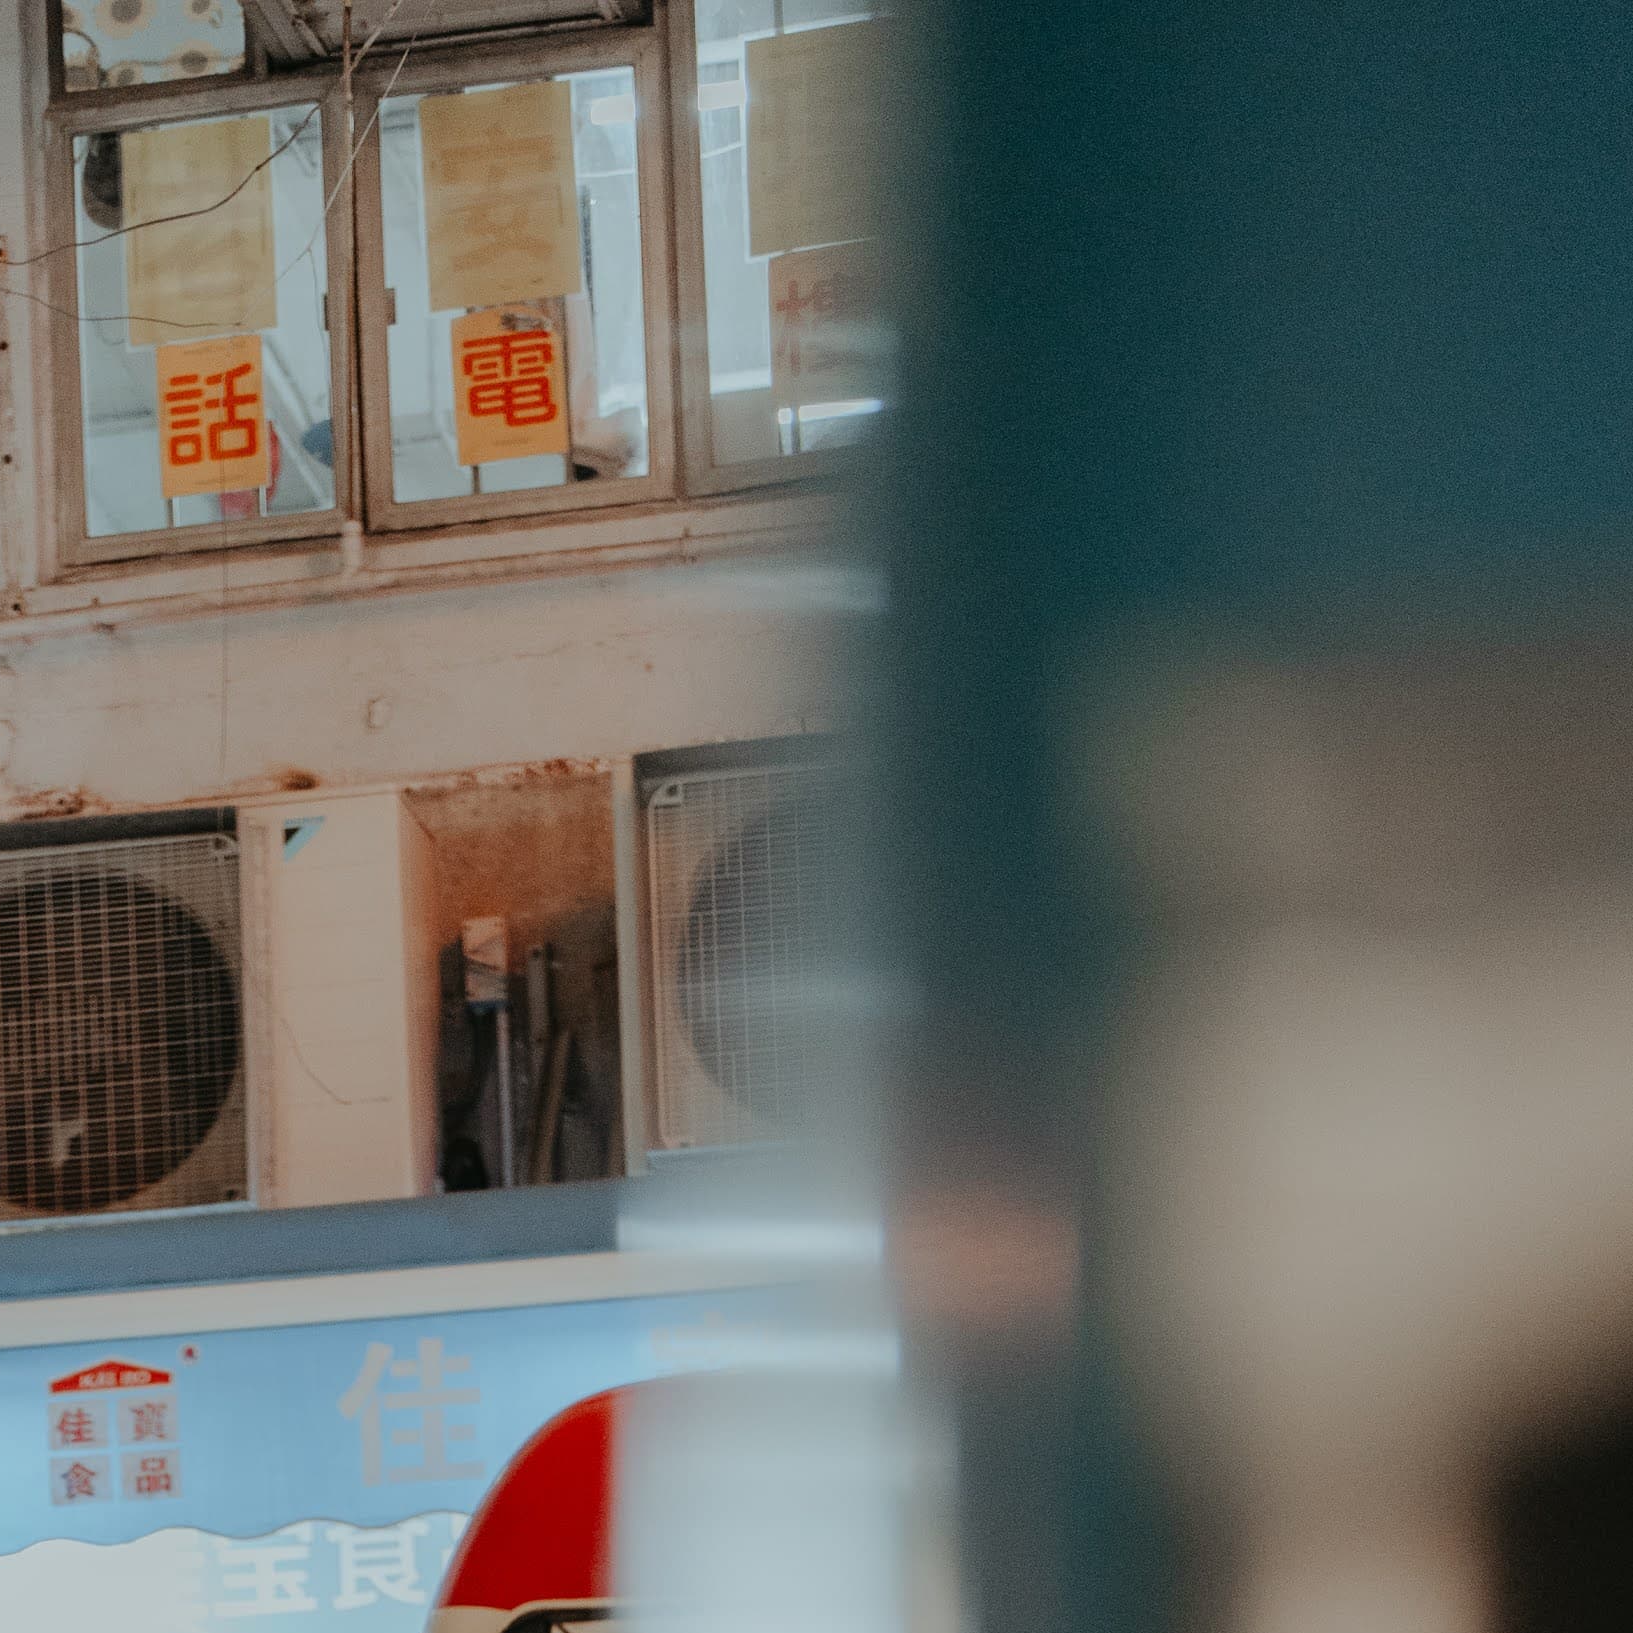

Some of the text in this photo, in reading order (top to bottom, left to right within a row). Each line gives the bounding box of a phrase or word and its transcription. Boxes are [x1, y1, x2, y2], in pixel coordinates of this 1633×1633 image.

[165, 362, 258, 467] 話
[462, 330, 560, 429] 電
[336, 1335, 487, 1488] 佳
